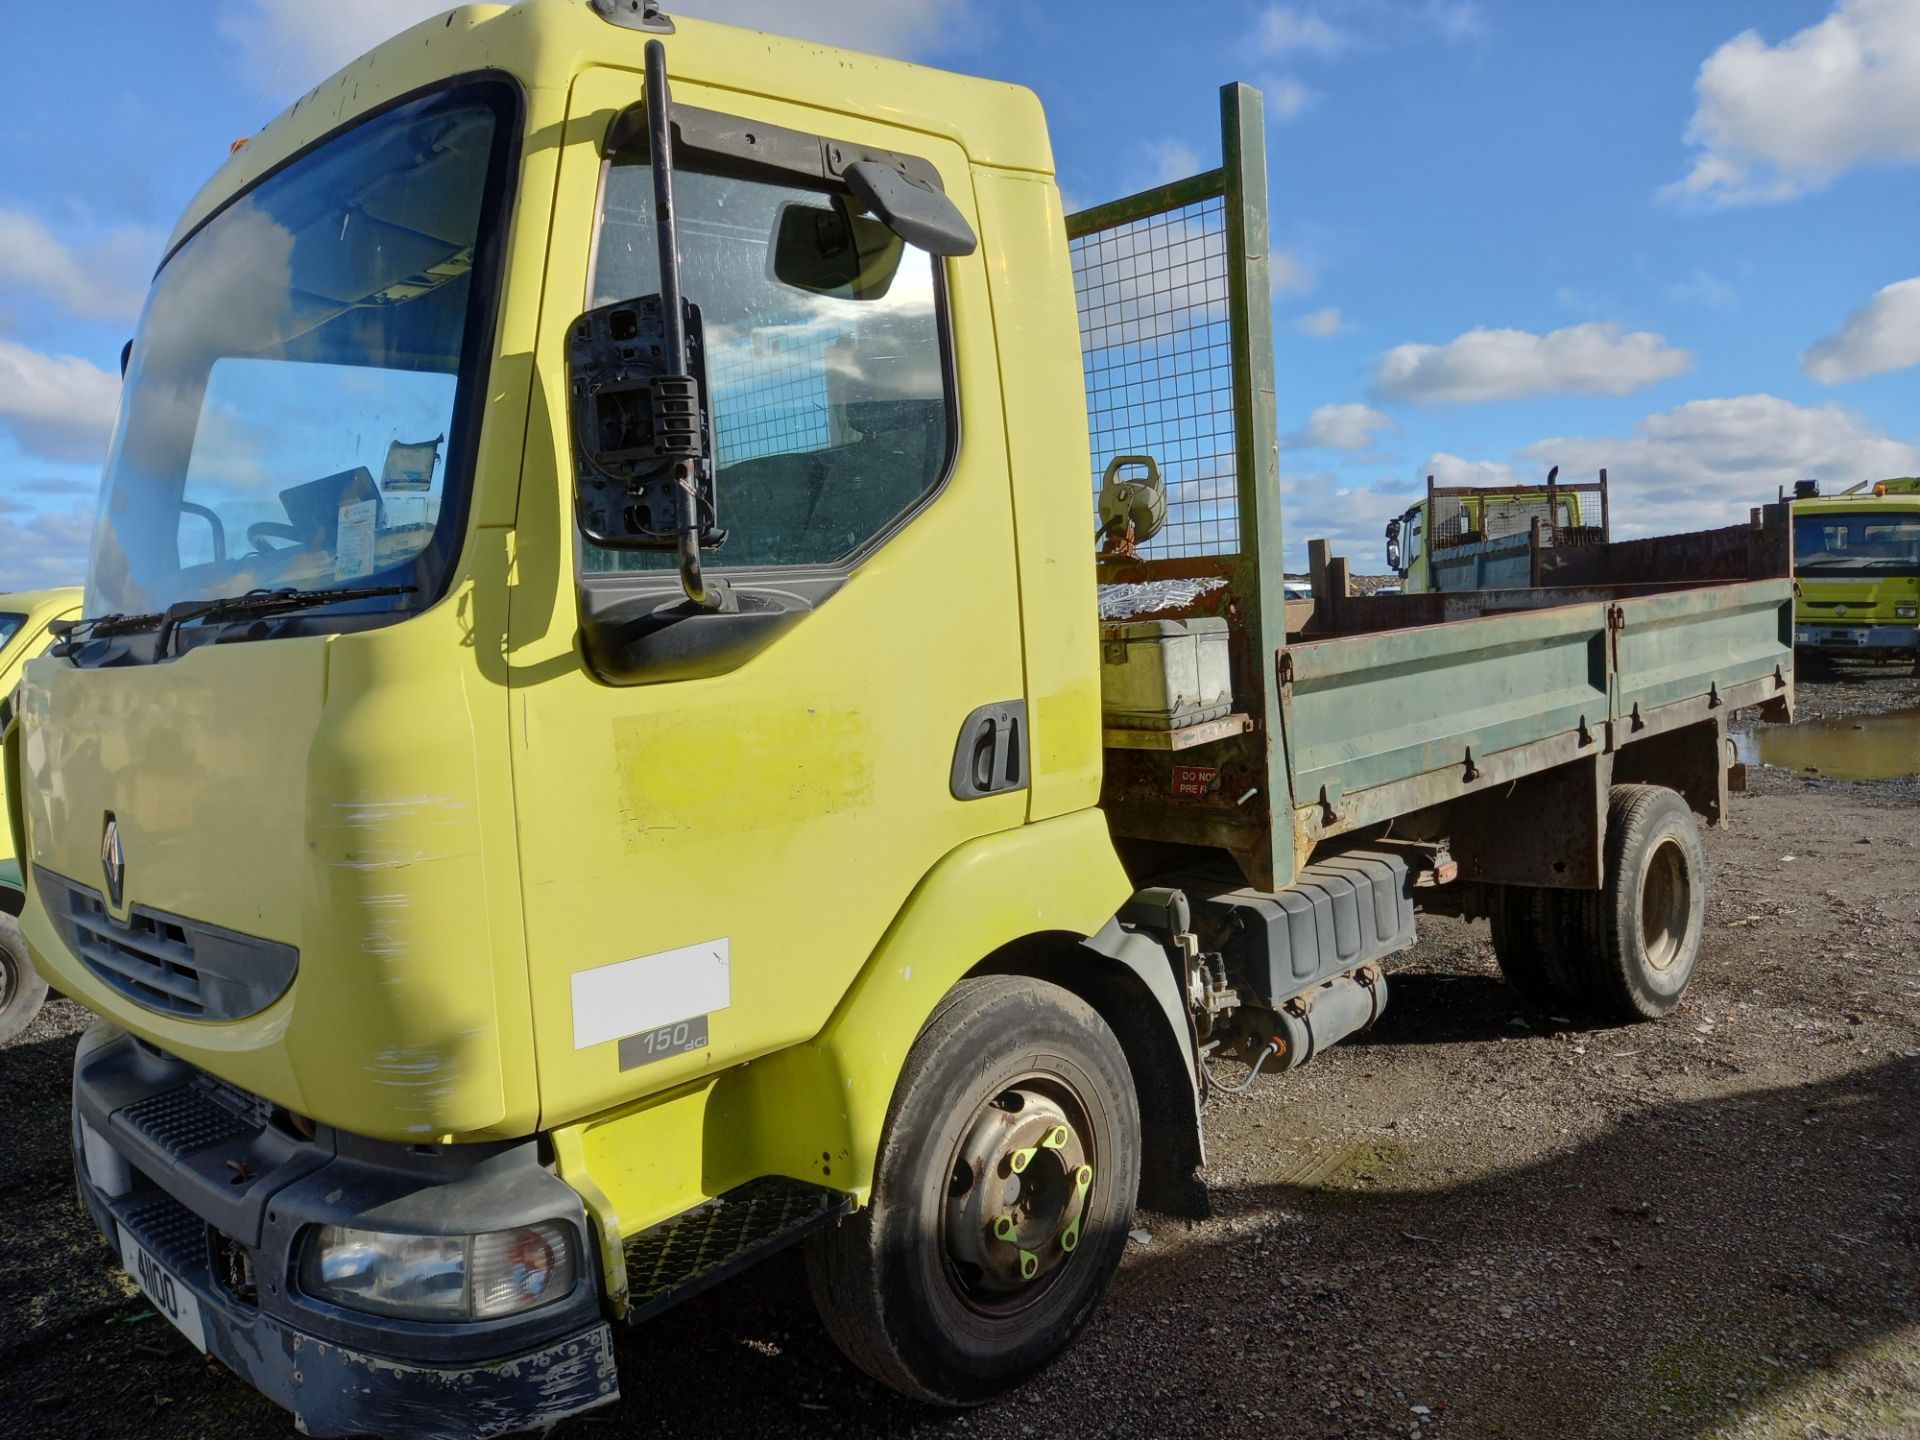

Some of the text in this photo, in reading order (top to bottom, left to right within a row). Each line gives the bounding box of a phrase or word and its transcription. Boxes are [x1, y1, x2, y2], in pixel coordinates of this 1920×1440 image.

[1182, 771, 1217, 782] DO NOT
[1179, 783, 1198, 794] PRE
[643, 1022, 689, 1054] 150
